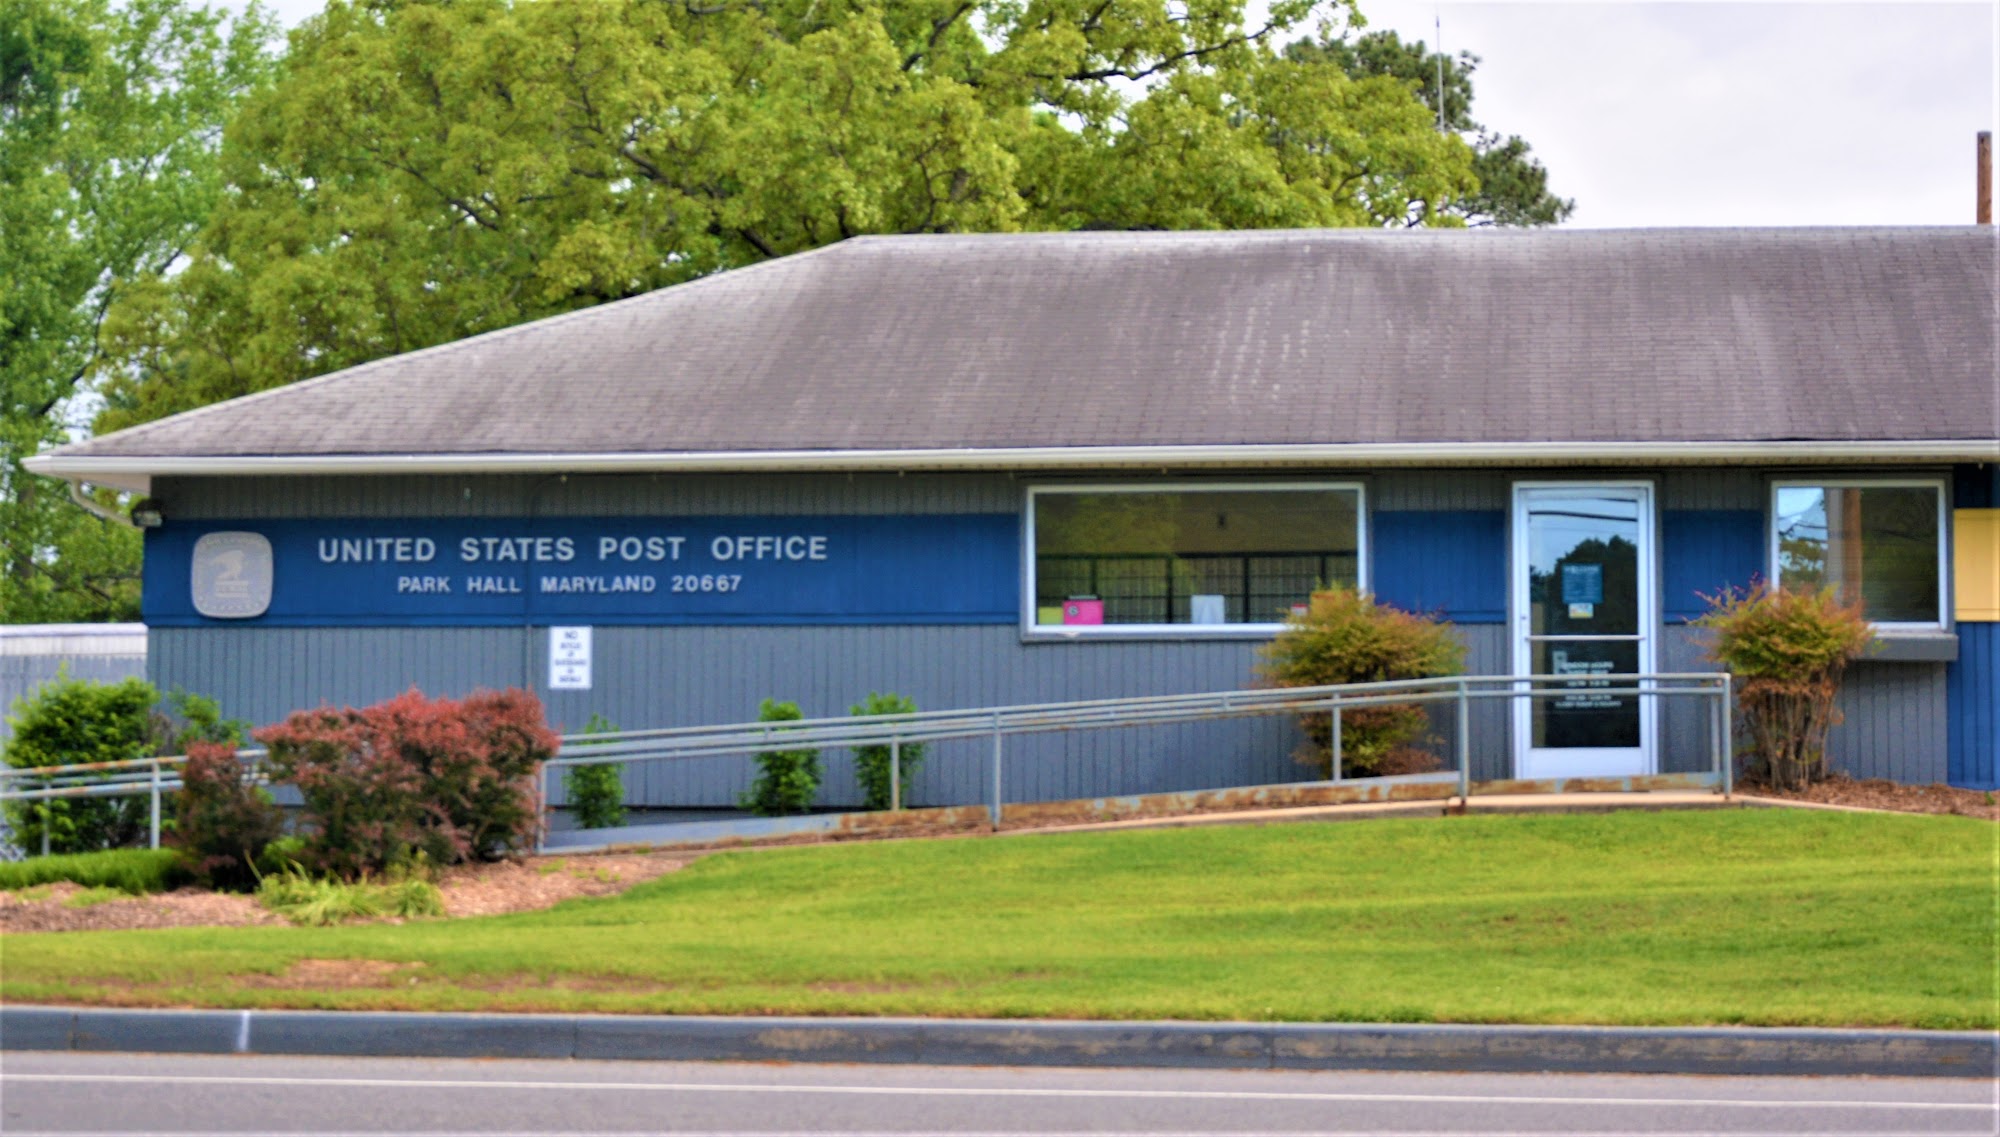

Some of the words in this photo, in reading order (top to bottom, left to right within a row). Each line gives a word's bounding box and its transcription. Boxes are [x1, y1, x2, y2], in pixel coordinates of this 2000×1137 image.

[318, 538, 434, 562] UNITED
[461, 537, 575, 562] STATES
[599, 537, 686, 561] POST
[711, 536, 828, 561] OFFICE
[397, 575, 451, 593] PARK
[467, 576, 520, 593] HALL
[541, 575, 656, 593] MARYLAND
[671, 574, 742, 592] 20667
